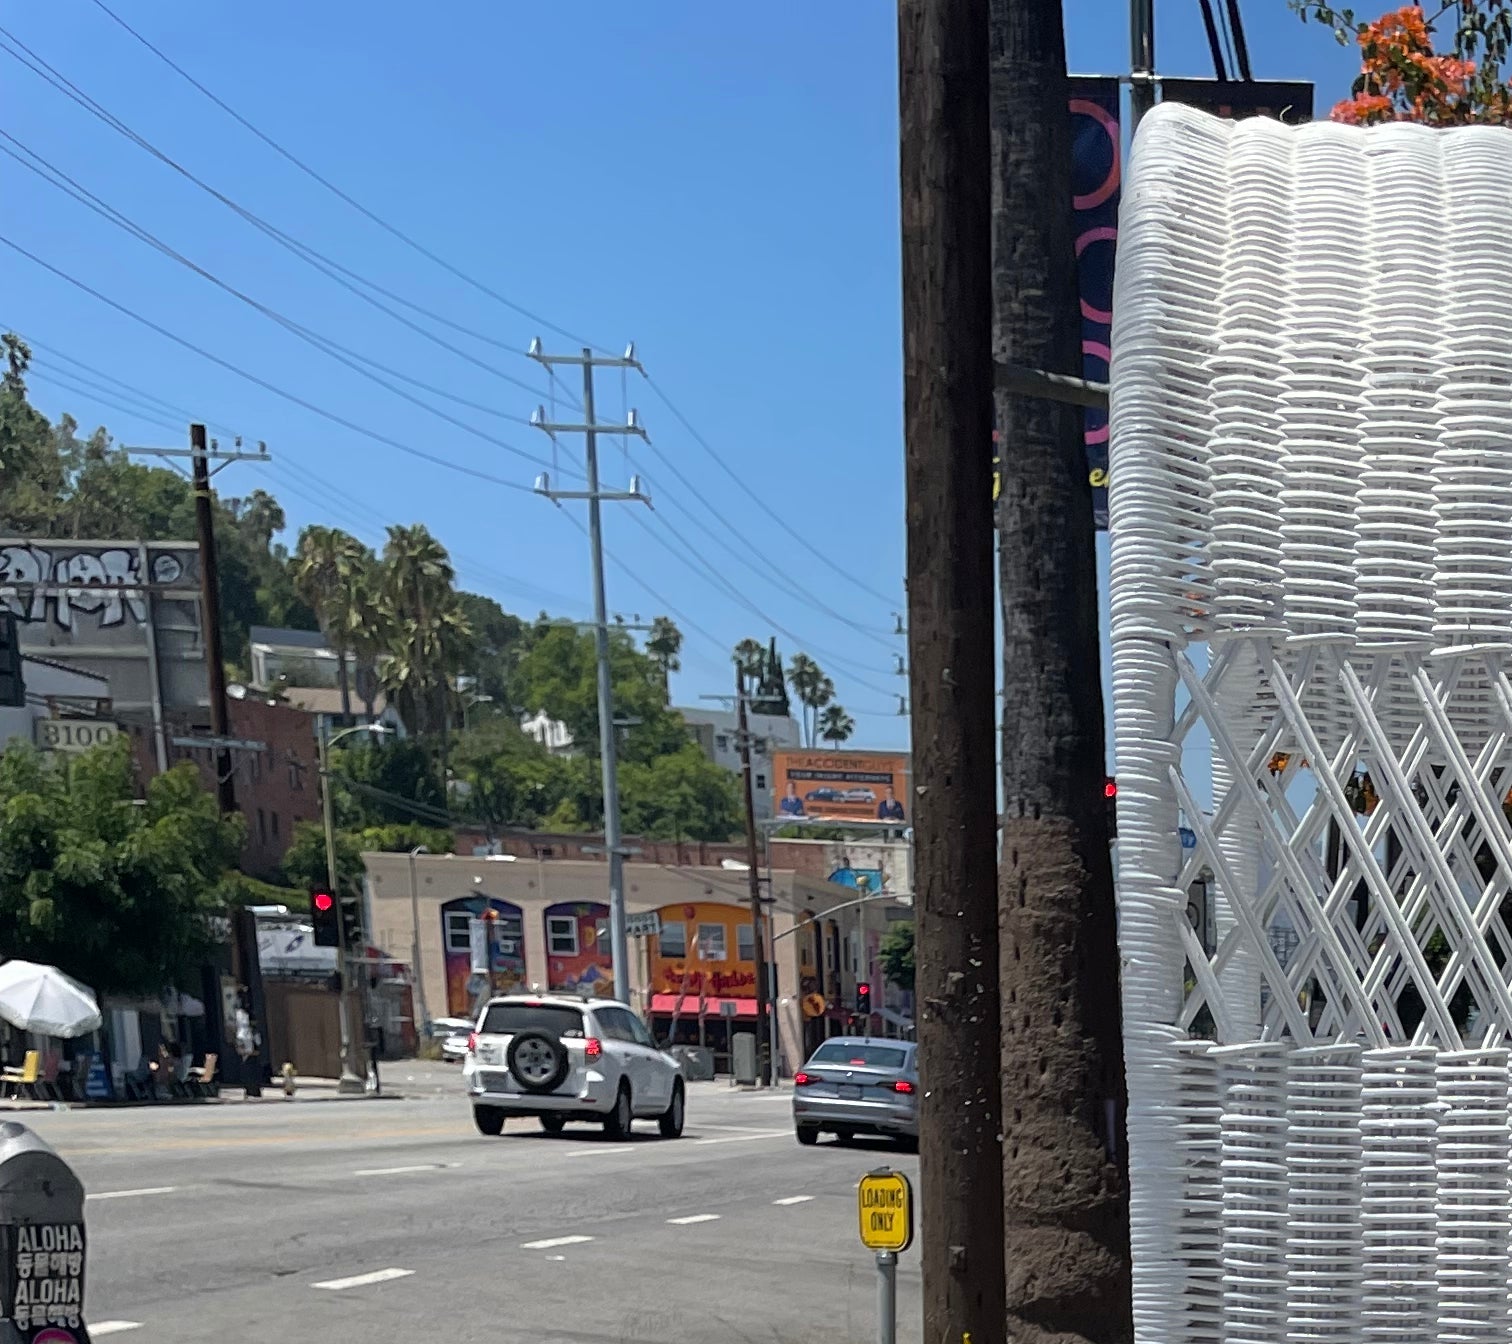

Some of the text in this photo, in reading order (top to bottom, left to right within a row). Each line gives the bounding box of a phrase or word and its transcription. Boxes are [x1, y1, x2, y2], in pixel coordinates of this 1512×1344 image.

[861, 1187, 903, 1209] LOADING
[870, 1211, 895, 1232] ONLY
[17, 1225, 83, 1252] ALOHA
[15, 1278, 80, 1304] ALOHA
